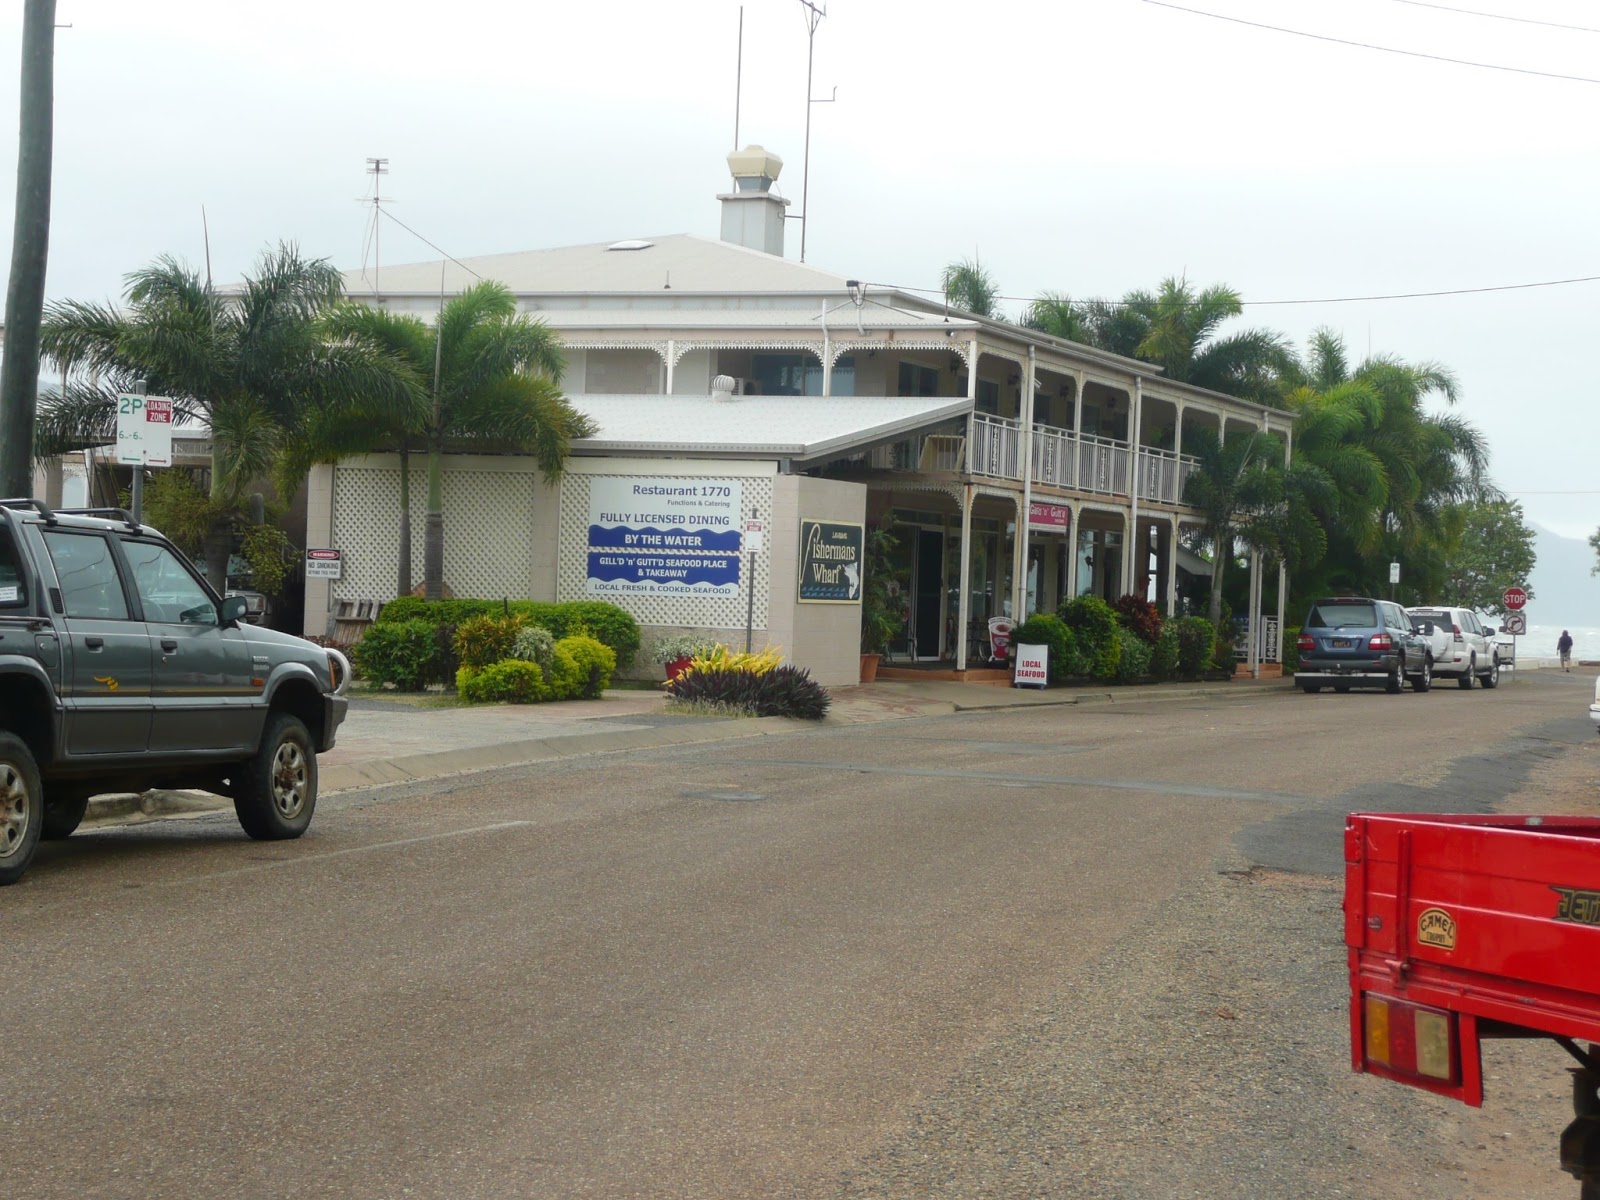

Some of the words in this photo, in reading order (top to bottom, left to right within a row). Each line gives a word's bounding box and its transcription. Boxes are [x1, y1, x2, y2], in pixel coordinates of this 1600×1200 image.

[120, 398, 143, 414] 2P
[147, 400, 171, 411] LOADING
[150, 412, 167, 422] ZONE
[633, 484, 698, 496] Restaurant
[701, 486, 731, 497] 1770
[704, 500, 731, 508] Catering
[600, 512, 631, 523] FULLY
[634, 513, 686, 524] LICENSED
[689, 515, 730, 526] DINING
[624, 534, 640, 544] BY
[641, 534, 662, 545] THE
[664, 535, 702, 546] WATER
[317, 562, 339, 570] SMOKING
[599, 557, 625, 566] GILL'D
[637, 558, 665, 567] GUTT'D
[665, 558, 702, 568] SEAFOOD
[703, 560, 728, 569] PLACE
[637, 568, 644, 576] &
[646, 568, 688, 577] TAKEAWAY
[812, 562, 842, 584] Wharf
[621, 584, 648, 592] FRESH
[657, 585, 691, 593] COOKED
[692, 586, 731, 595] SEAFOOD
[1504, 594, 1526, 604] STOP
[1022, 660, 1041, 669] LOCAL
[1017, 669, 1046, 679] SEAFOOD
[1420, 914, 1456, 940] CAMEL
